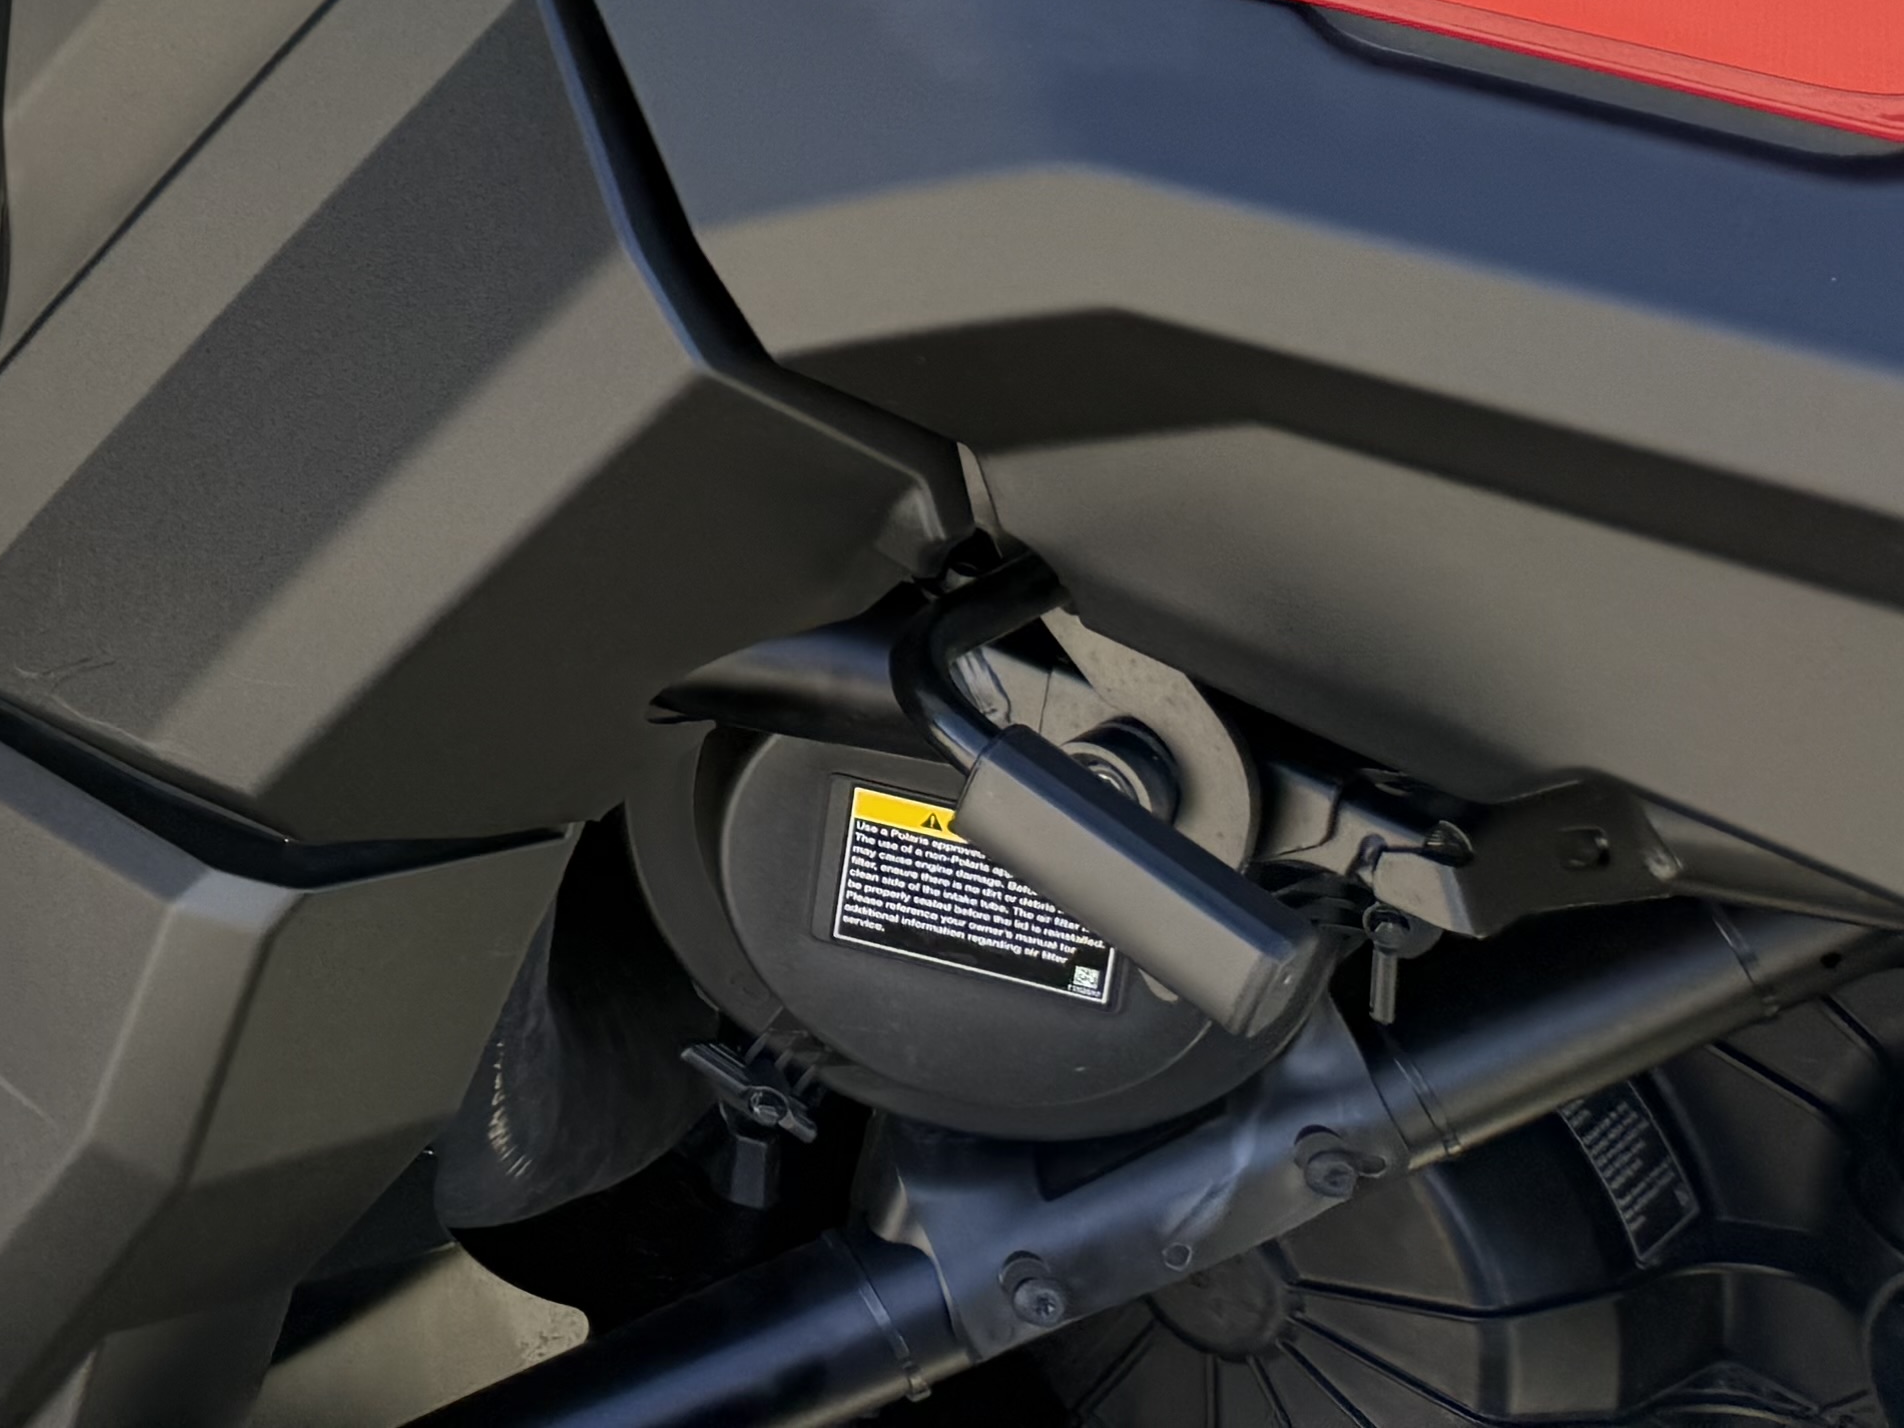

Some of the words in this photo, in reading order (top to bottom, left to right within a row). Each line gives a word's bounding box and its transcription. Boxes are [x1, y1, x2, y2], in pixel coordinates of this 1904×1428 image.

[856, 832, 875, 845] The
[878, 840, 898, 850] use
[901, 845, 913, 853] of
[925, 851, 989, 872] non-Polaris
[857, 821, 878, 833] Use
[891, 829, 929, 845] Polaris
[852, 856, 877, 870] filter,
[880, 865, 918, 879] ensure
[921, 873, 950, 887] there
[952, 880, 962, 890] is
[965, 885, 980, 894] no
[982, 889, 1002, 900] dirt
[1019, 898, 1055, 912] debris
[853, 846, 876, 858] may
[879, 852, 912, 865] cause
[915, 861, 953, 875] engine
[956, 870, 1004, 888] damage.
[843, 915, 884, 931] service.
[846, 890, 883, 907] Please
[886, 902, 938, 920] reference
[941, 915, 966, 926] your
[969, 922, 1013, 939] owner's
[1015, 934, 1057, 949] manual
[1060, 943, 1076, 953] for
[848, 879, 862, 889] be
[864, 885, 911, 903] properly
[914, 896, 952, 911] seated
[954, 905, 990, 921] before
[993, 915, 1012, 926] the
[1014, 919, 1029, 930] lid
[1031, 924, 1041, 933] is
[850, 869, 879, 882] clean
[882, 877, 905, 888] side
[908, 883, 920, 891] of
[923, 885, 940, 896] the
[943, 890, 977, 905] intake
[980, 900, 1008, 913] tube.
[1013, 907, 1034, 919] The
[1036, 915, 1052, 923] air
[1054, 917, 1080, 930] filter
[844, 904, 899, 923] additional
[901, 916, 965, 939] information
[968, 934, 1022, 954] regarding
[1024, 948, 1039, 957] air
[1042, 951, 1068, 963] filter
